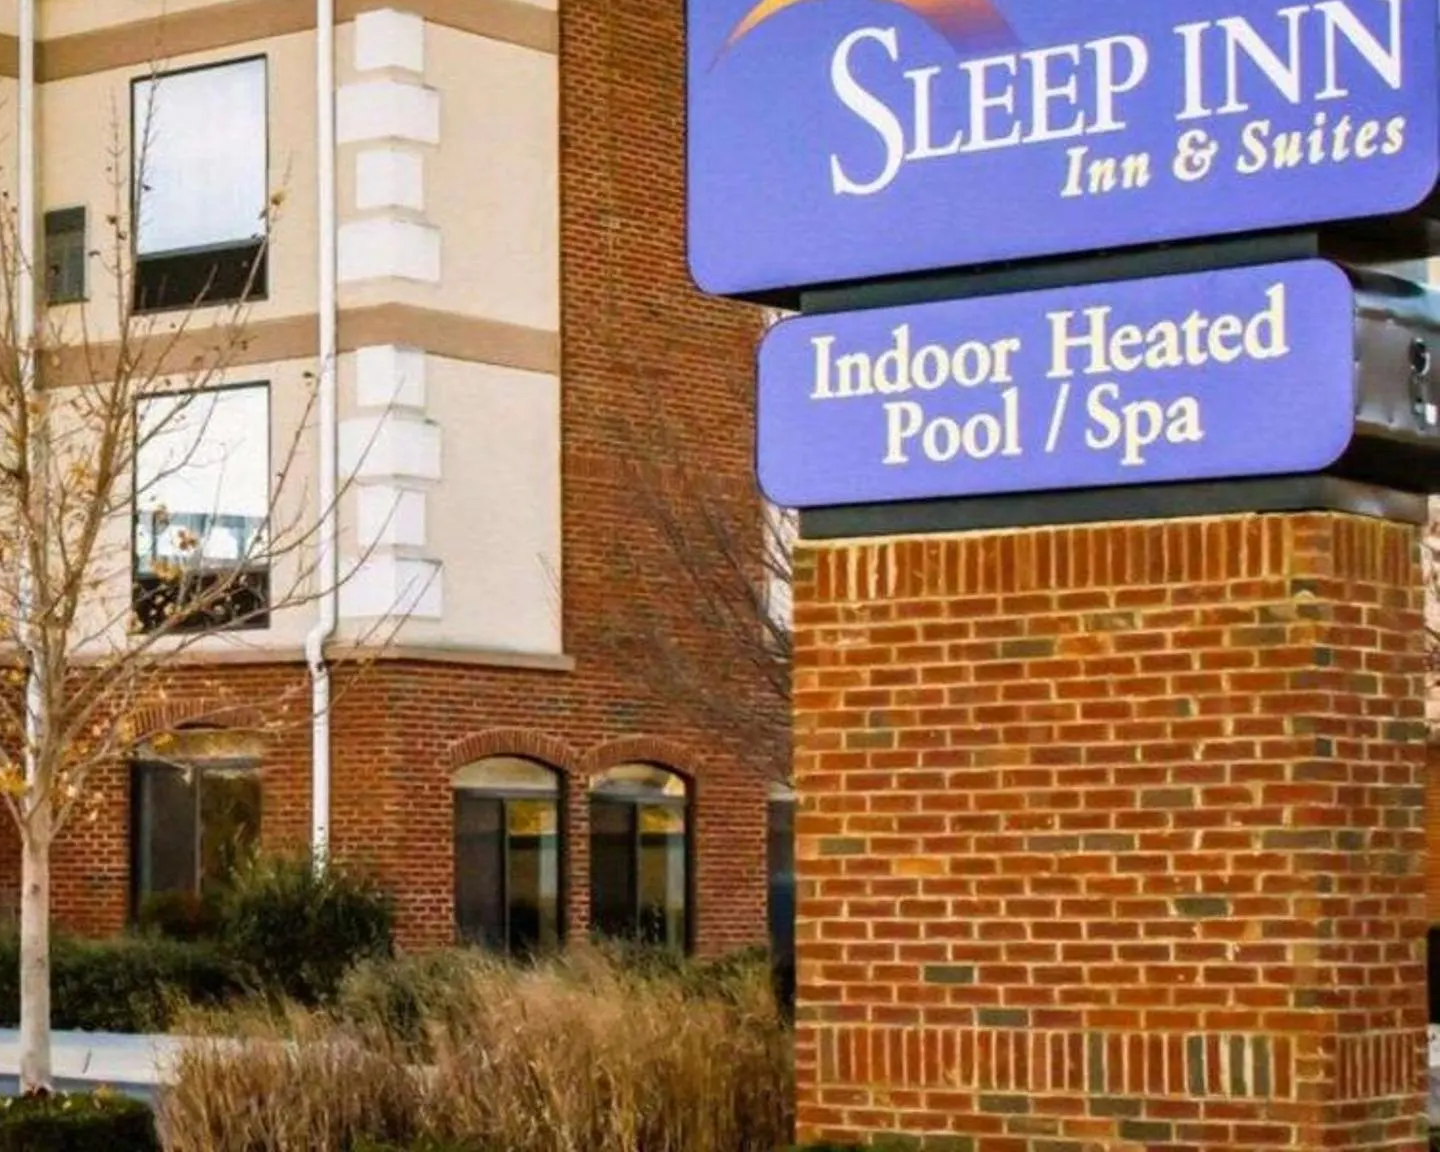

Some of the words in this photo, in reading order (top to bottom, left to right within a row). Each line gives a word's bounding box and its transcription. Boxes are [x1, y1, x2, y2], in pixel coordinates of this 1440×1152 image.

[830, 26, 1148, 196] SLEEP
[1061, 148, 1151, 198] Inn
[1173, 132, 1217, 182] &
[1235, 112, 1408, 174] Suites
[810, 323, 1020, 400] Indoor
[1046, 283, 1289, 379] Heated
[882, 389, 1021, 465] Pool
[1045, 382, 1069, 452] /
[1084, 385, 1203, 466] Spa
